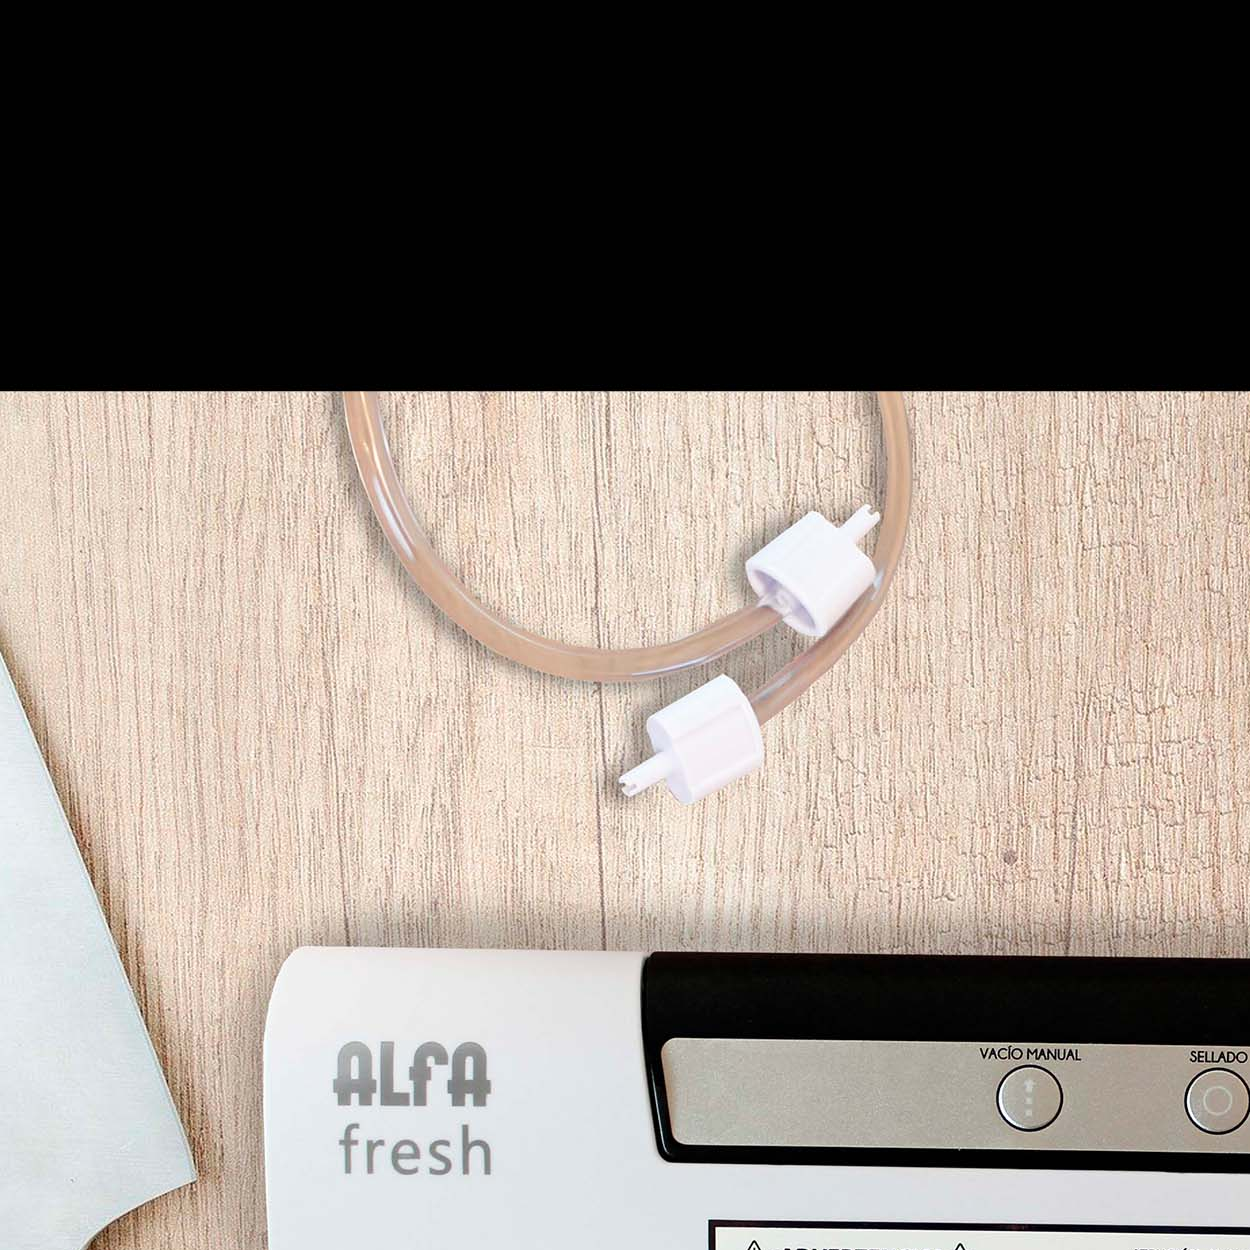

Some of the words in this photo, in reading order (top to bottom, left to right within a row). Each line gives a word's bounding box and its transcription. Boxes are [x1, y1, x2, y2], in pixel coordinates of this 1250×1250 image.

[980, 1045, 1023, 1060] VACÍO
[1027, 1048, 1081, 1061] MANUAL
[1190, 1051, 1248, 1063] SELLADO
[339, 1123, 491, 1176] fresh
